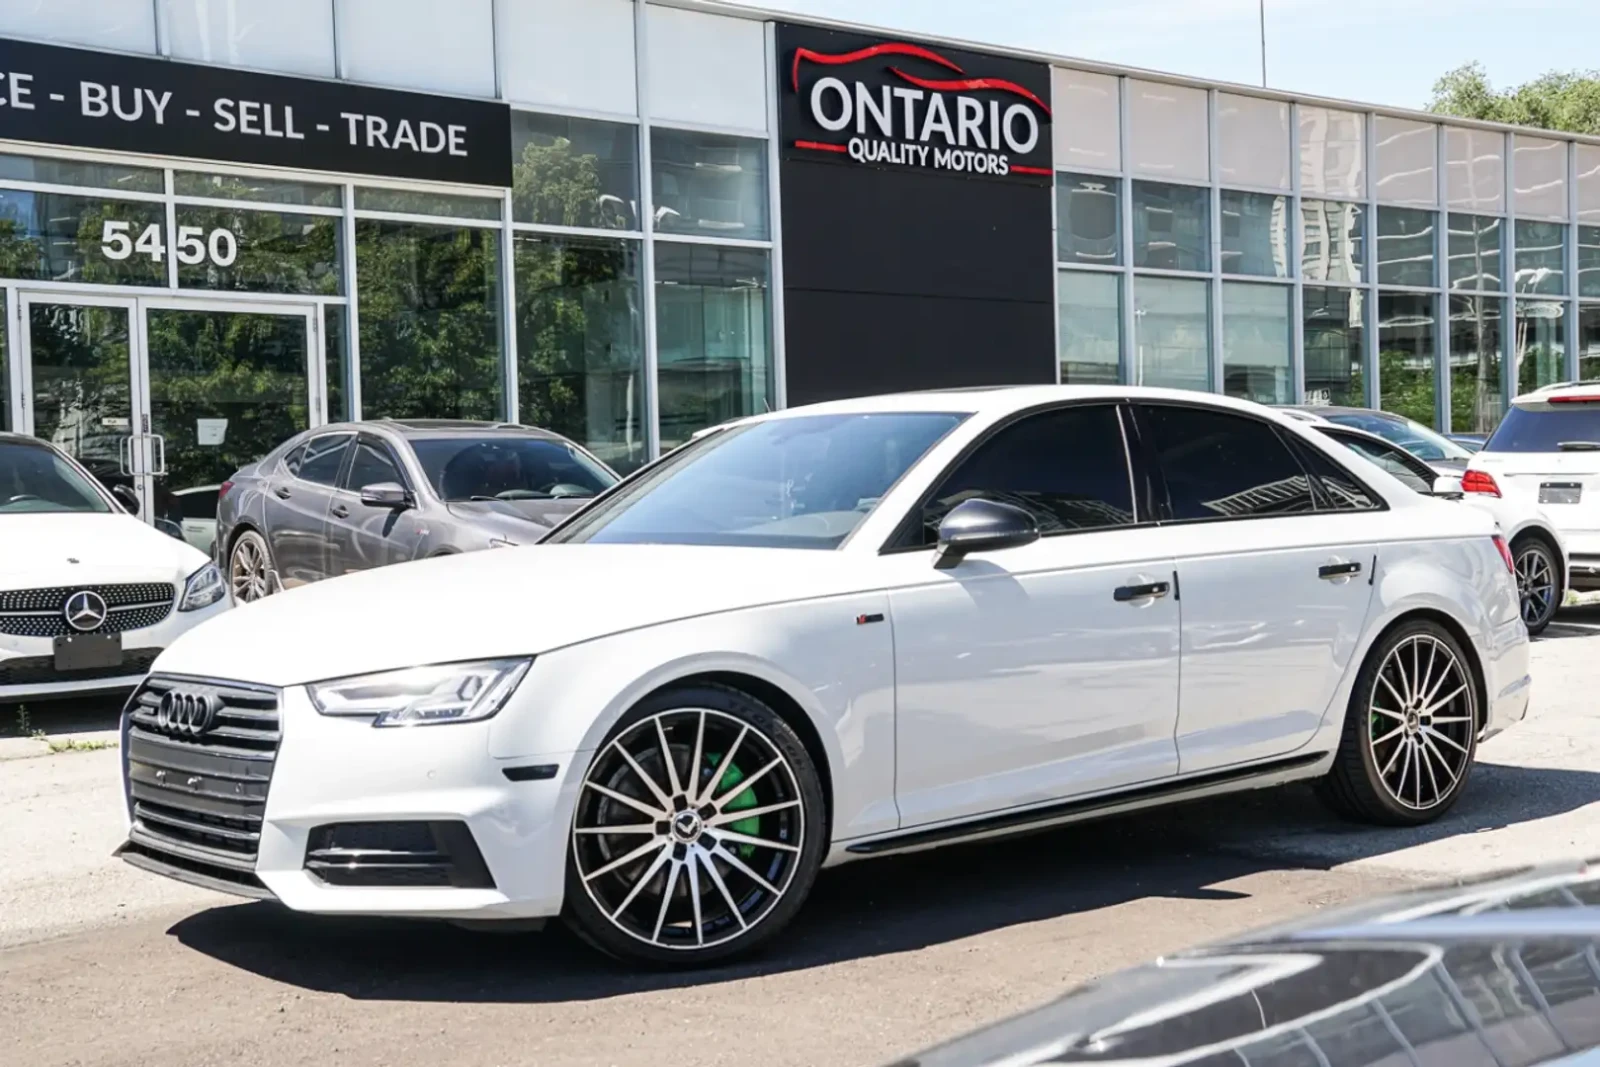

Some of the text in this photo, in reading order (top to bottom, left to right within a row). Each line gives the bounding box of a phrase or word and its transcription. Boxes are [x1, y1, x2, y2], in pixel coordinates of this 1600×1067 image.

[80, 80, 173, 125] BUY
[213, 97, 305, 140] SELL
[340, 112, 468, 157] TRADE
[810, 76, 1039, 154] ONTARIO
[848, 137, 1009, 176] QUALITY MOTORS
[101, 220, 237, 267] 5450
